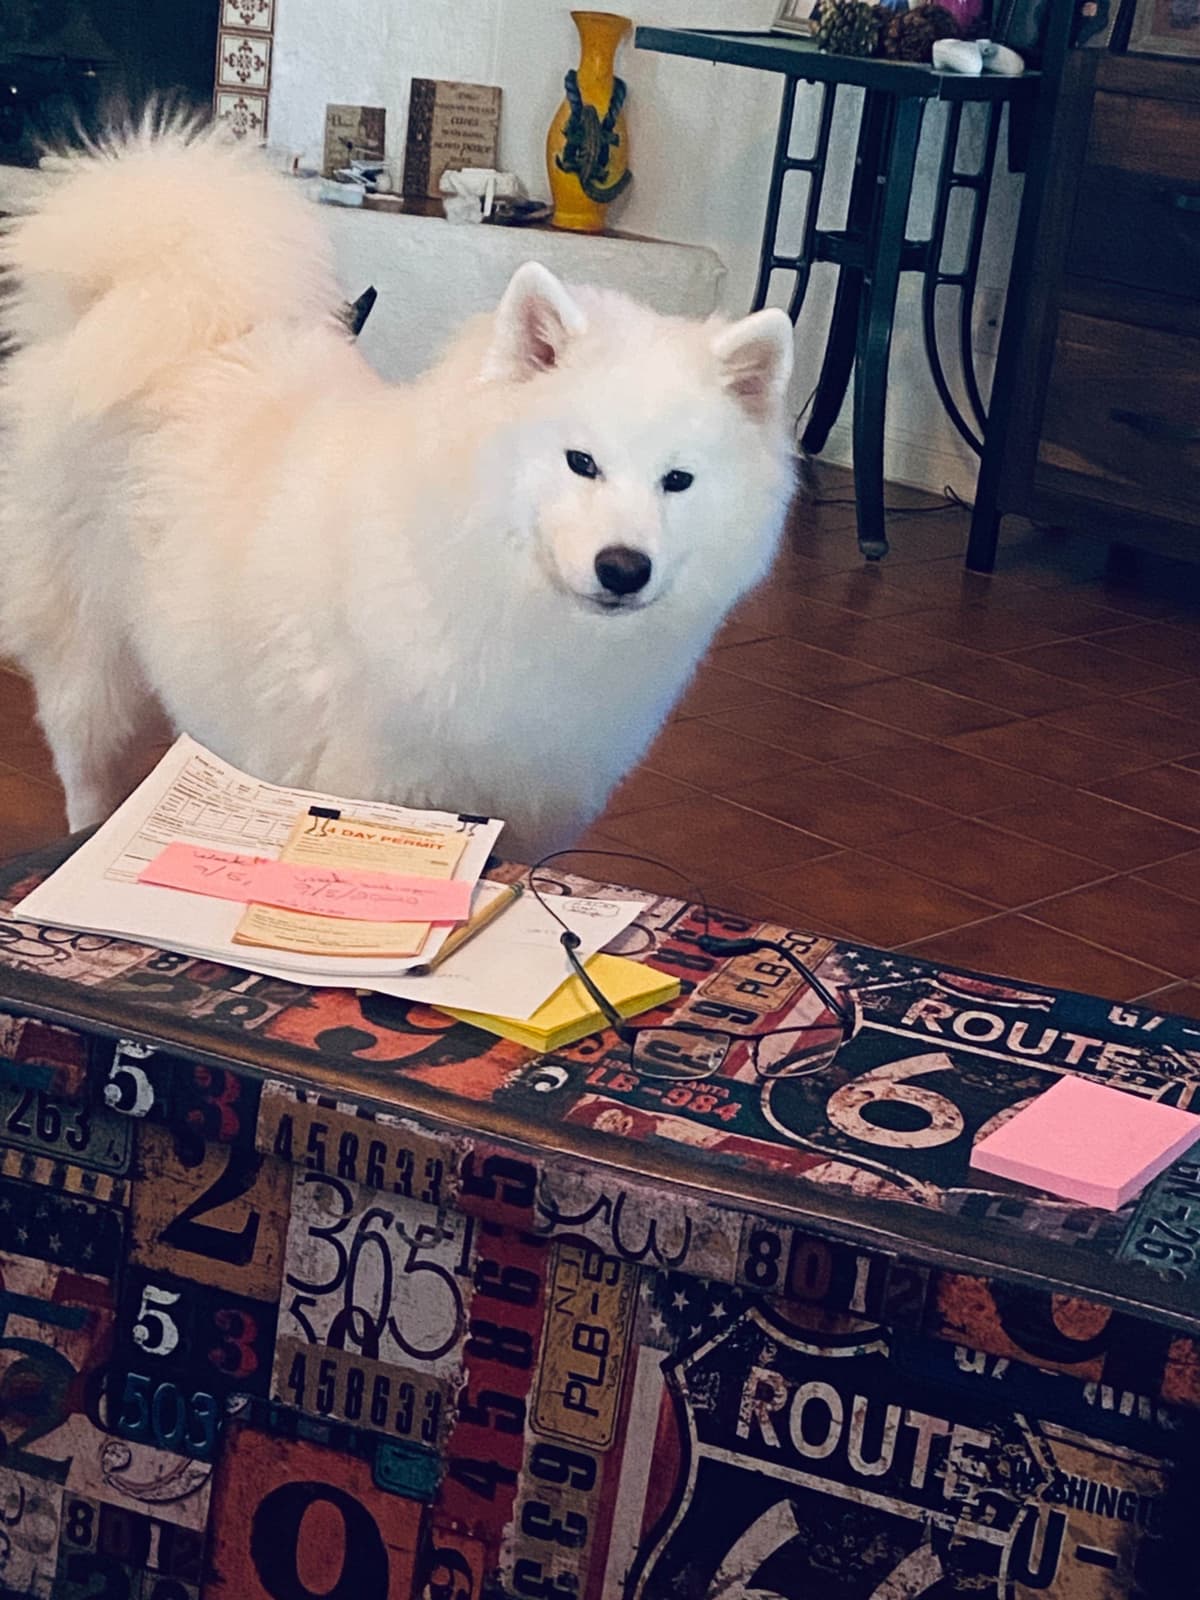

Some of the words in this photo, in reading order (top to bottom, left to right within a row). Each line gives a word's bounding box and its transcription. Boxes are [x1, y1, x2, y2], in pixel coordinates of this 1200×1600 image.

[342, 829, 377, 840] DAY
[380, 836, 446, 850] PERMIT
[104, 1038, 160, 1118] 5
[901, 998, 1142, 1073] ROUTE
[158, 1135, 263, 1267] 2
[273, 1113, 443, 1205] 458633
[132, 1284, 182, 1357] 5
[208, 1309, 260, 1378] 3
[288, 1351, 442, 1442] 458633
[736, 1365, 992, 1505] ROUTE
